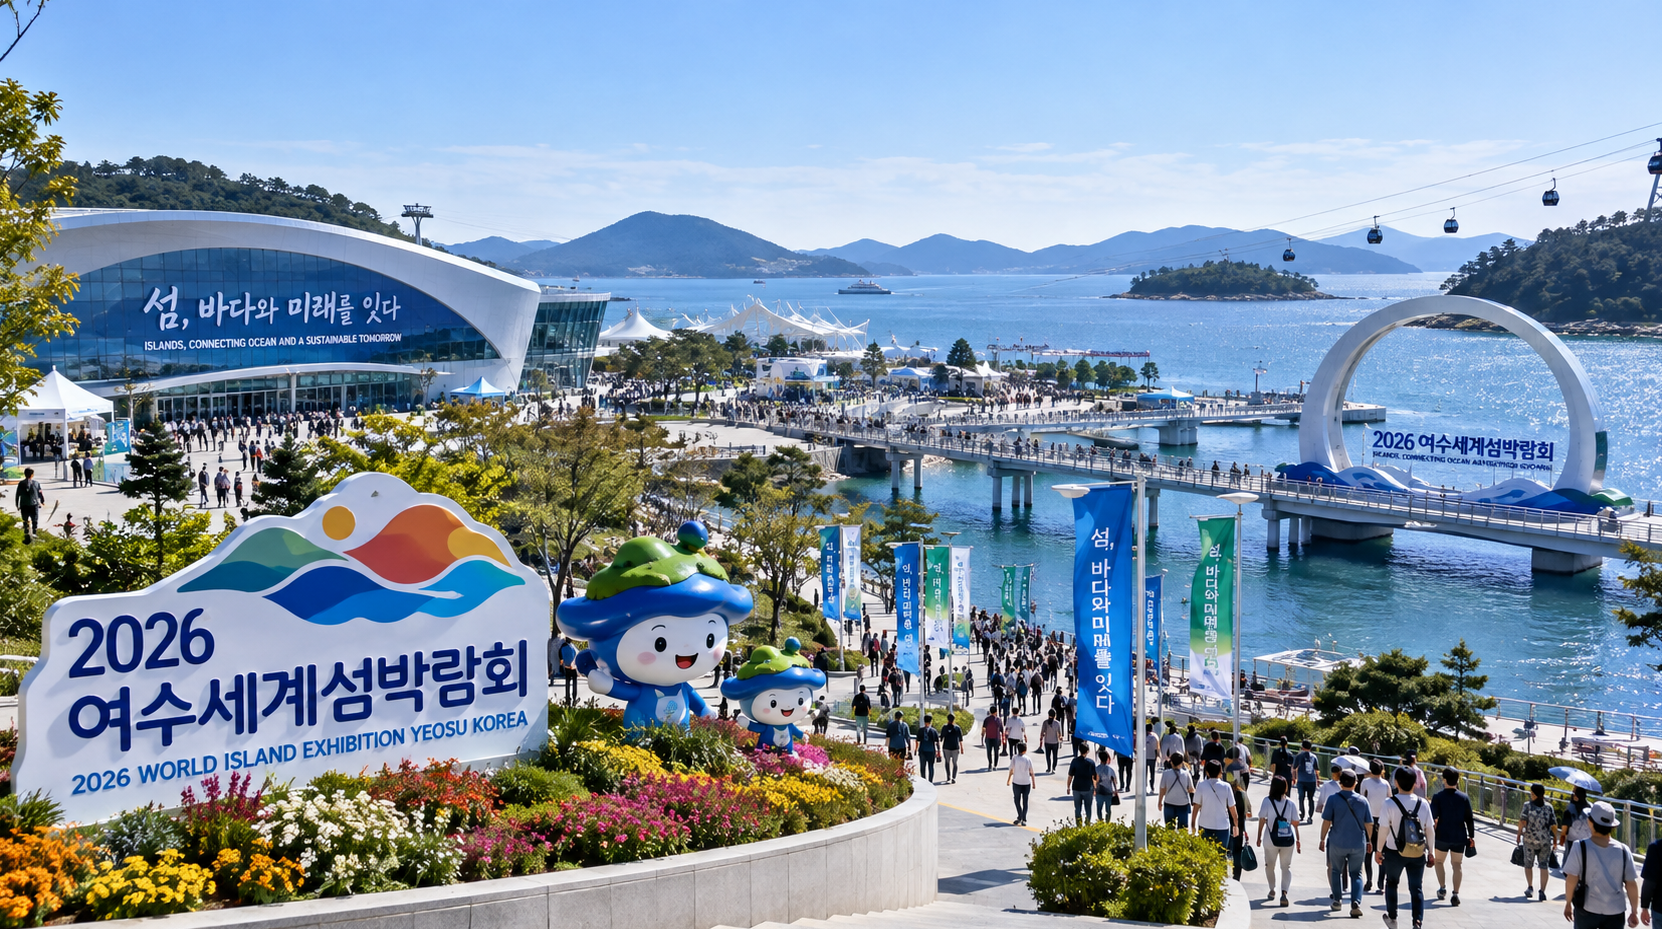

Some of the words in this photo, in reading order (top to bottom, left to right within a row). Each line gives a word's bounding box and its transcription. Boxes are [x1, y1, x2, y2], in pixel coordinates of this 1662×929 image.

[143, 285, 189, 331] 섬,
[198, 291, 279, 327] 바다와
[288, 290, 355, 326] 미래를
[362, 291, 401, 325] 잇다
[144, 340, 187, 351] ISLANDS,
[188, 338, 246, 349] CONNECTING
[248, 336, 277, 347] OCEAN
[278, 336, 297, 346] AND
[298, 336, 305, 345] A
[305, 334, 358, 345] SUSTAINABLE
[359, 333, 402, 343] TOMORROW
[1372, 430, 1415, 451] 2026
[1418, 433, 1554, 462] 여수세계섬박람회
[1091, 527, 1114, 551] 섬,
[68, 608, 215, 678] 2026
[68, 639, 528, 752] 여수세계섬박람회
[1095, 672, 1115, 714] 잇다
[71, 768, 131, 795] 2026
[138, 755, 218, 784] WORLD
[224, 743, 297, 771] ISLAND
[303, 728, 405, 759] EXHIBITION
[410, 718, 468, 742] YEOSU
[473, 710, 528, 734] KOREA
